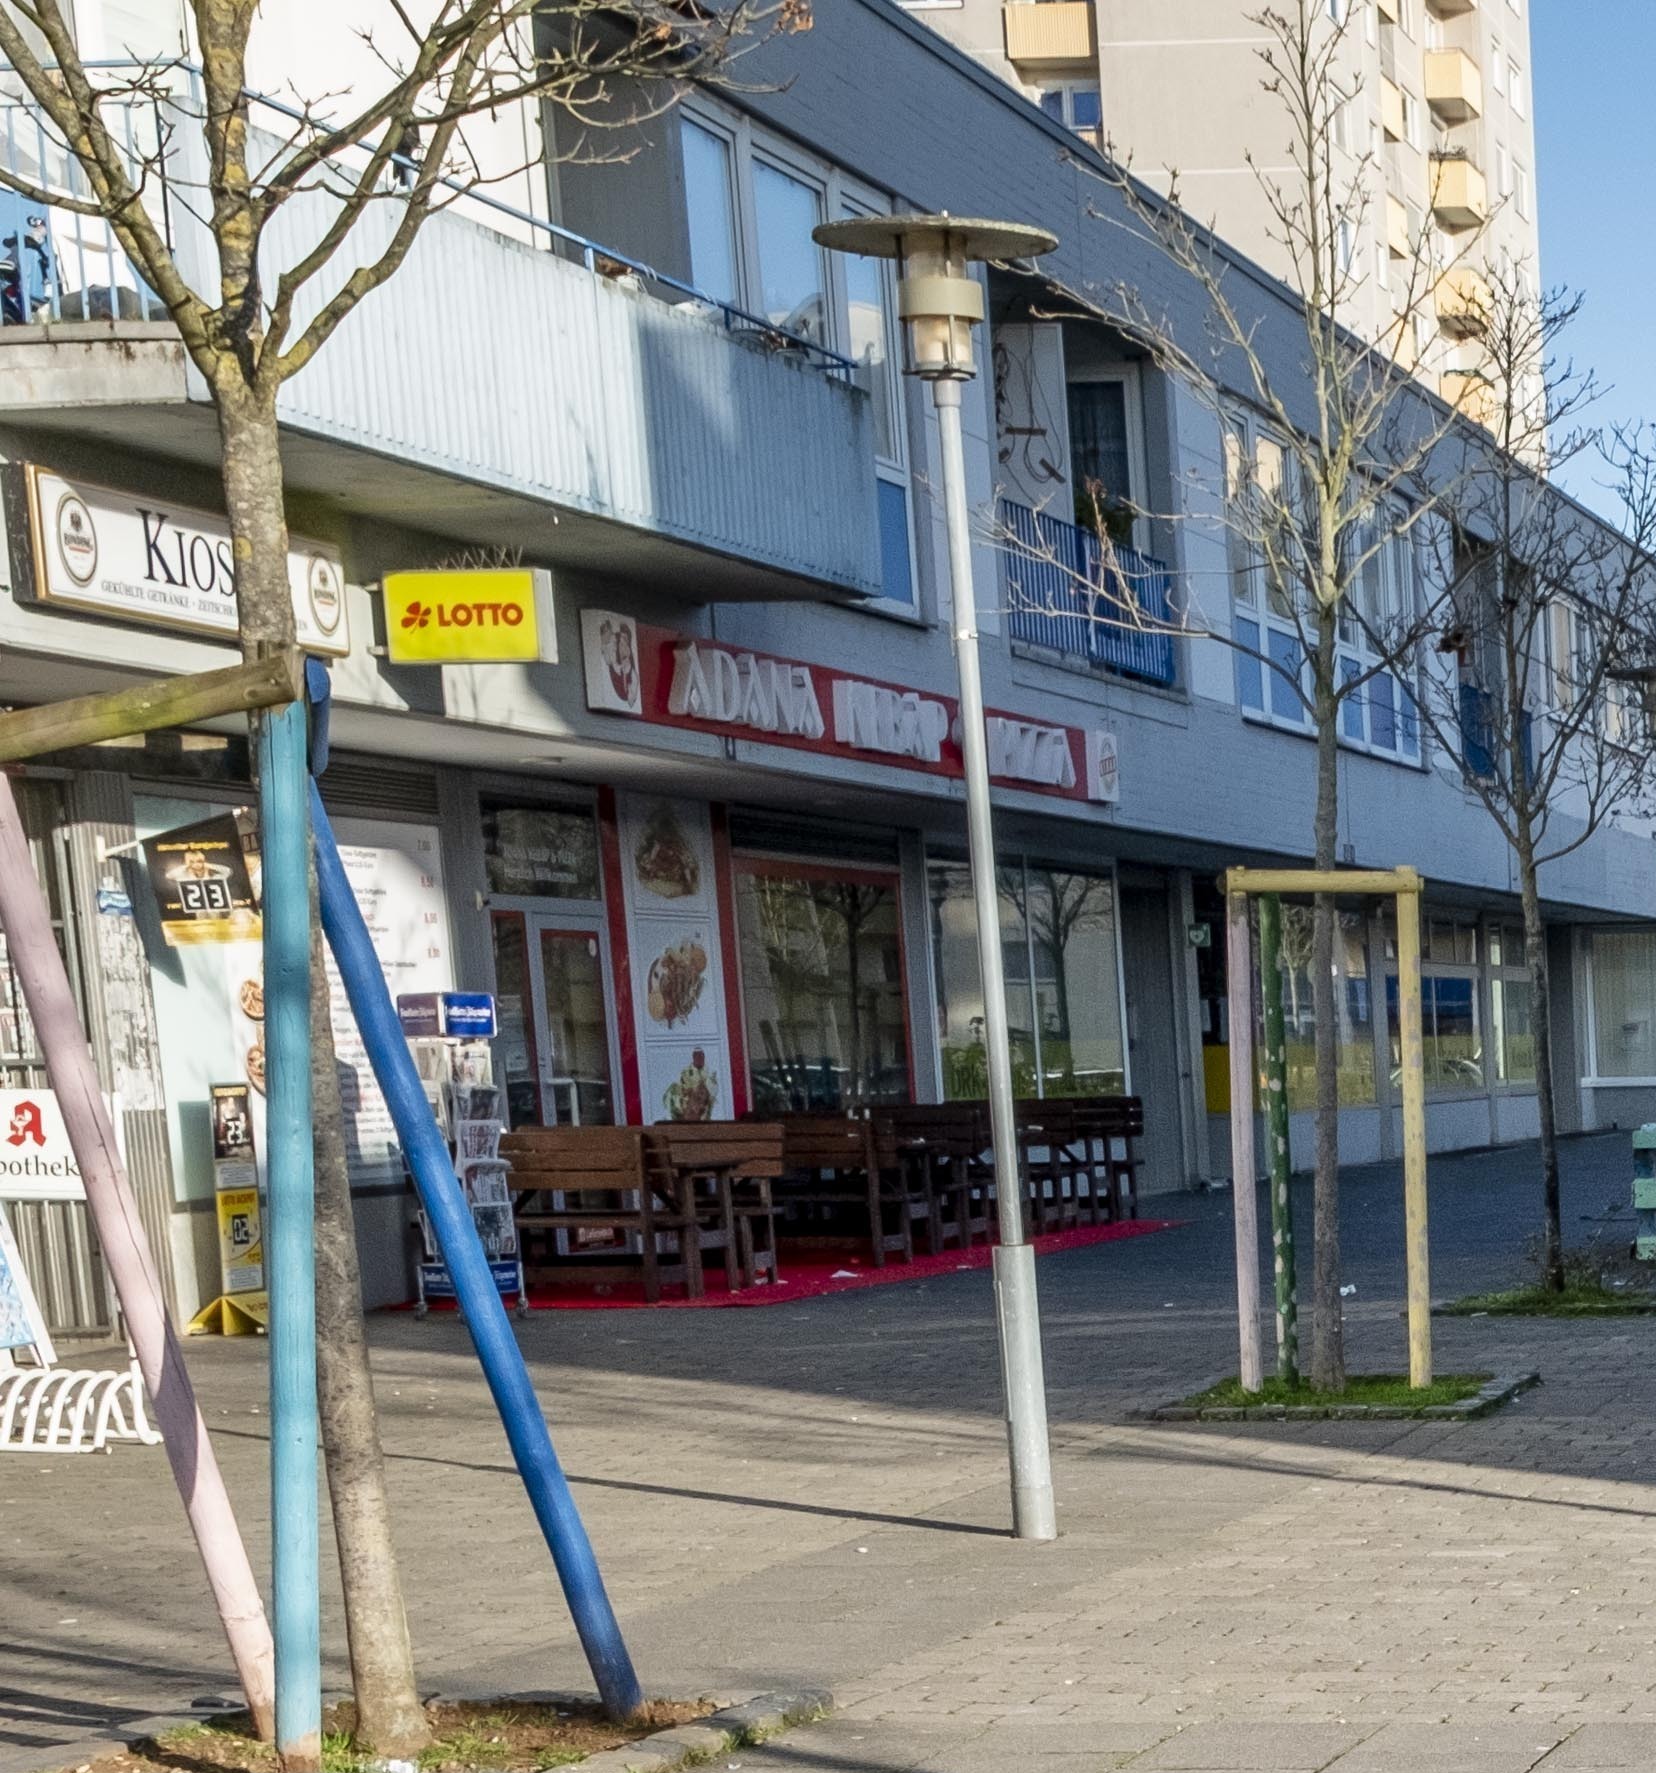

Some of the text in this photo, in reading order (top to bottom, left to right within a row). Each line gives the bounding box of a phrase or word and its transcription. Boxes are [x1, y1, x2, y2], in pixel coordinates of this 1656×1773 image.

[136, 508, 236, 597] KIOS
[437, 603, 523, 626] LOTTO
[667, 641, 825, 740] ADANA
[186, 884, 225, 908] 23
[0, 1154, 81, 1177] othek
